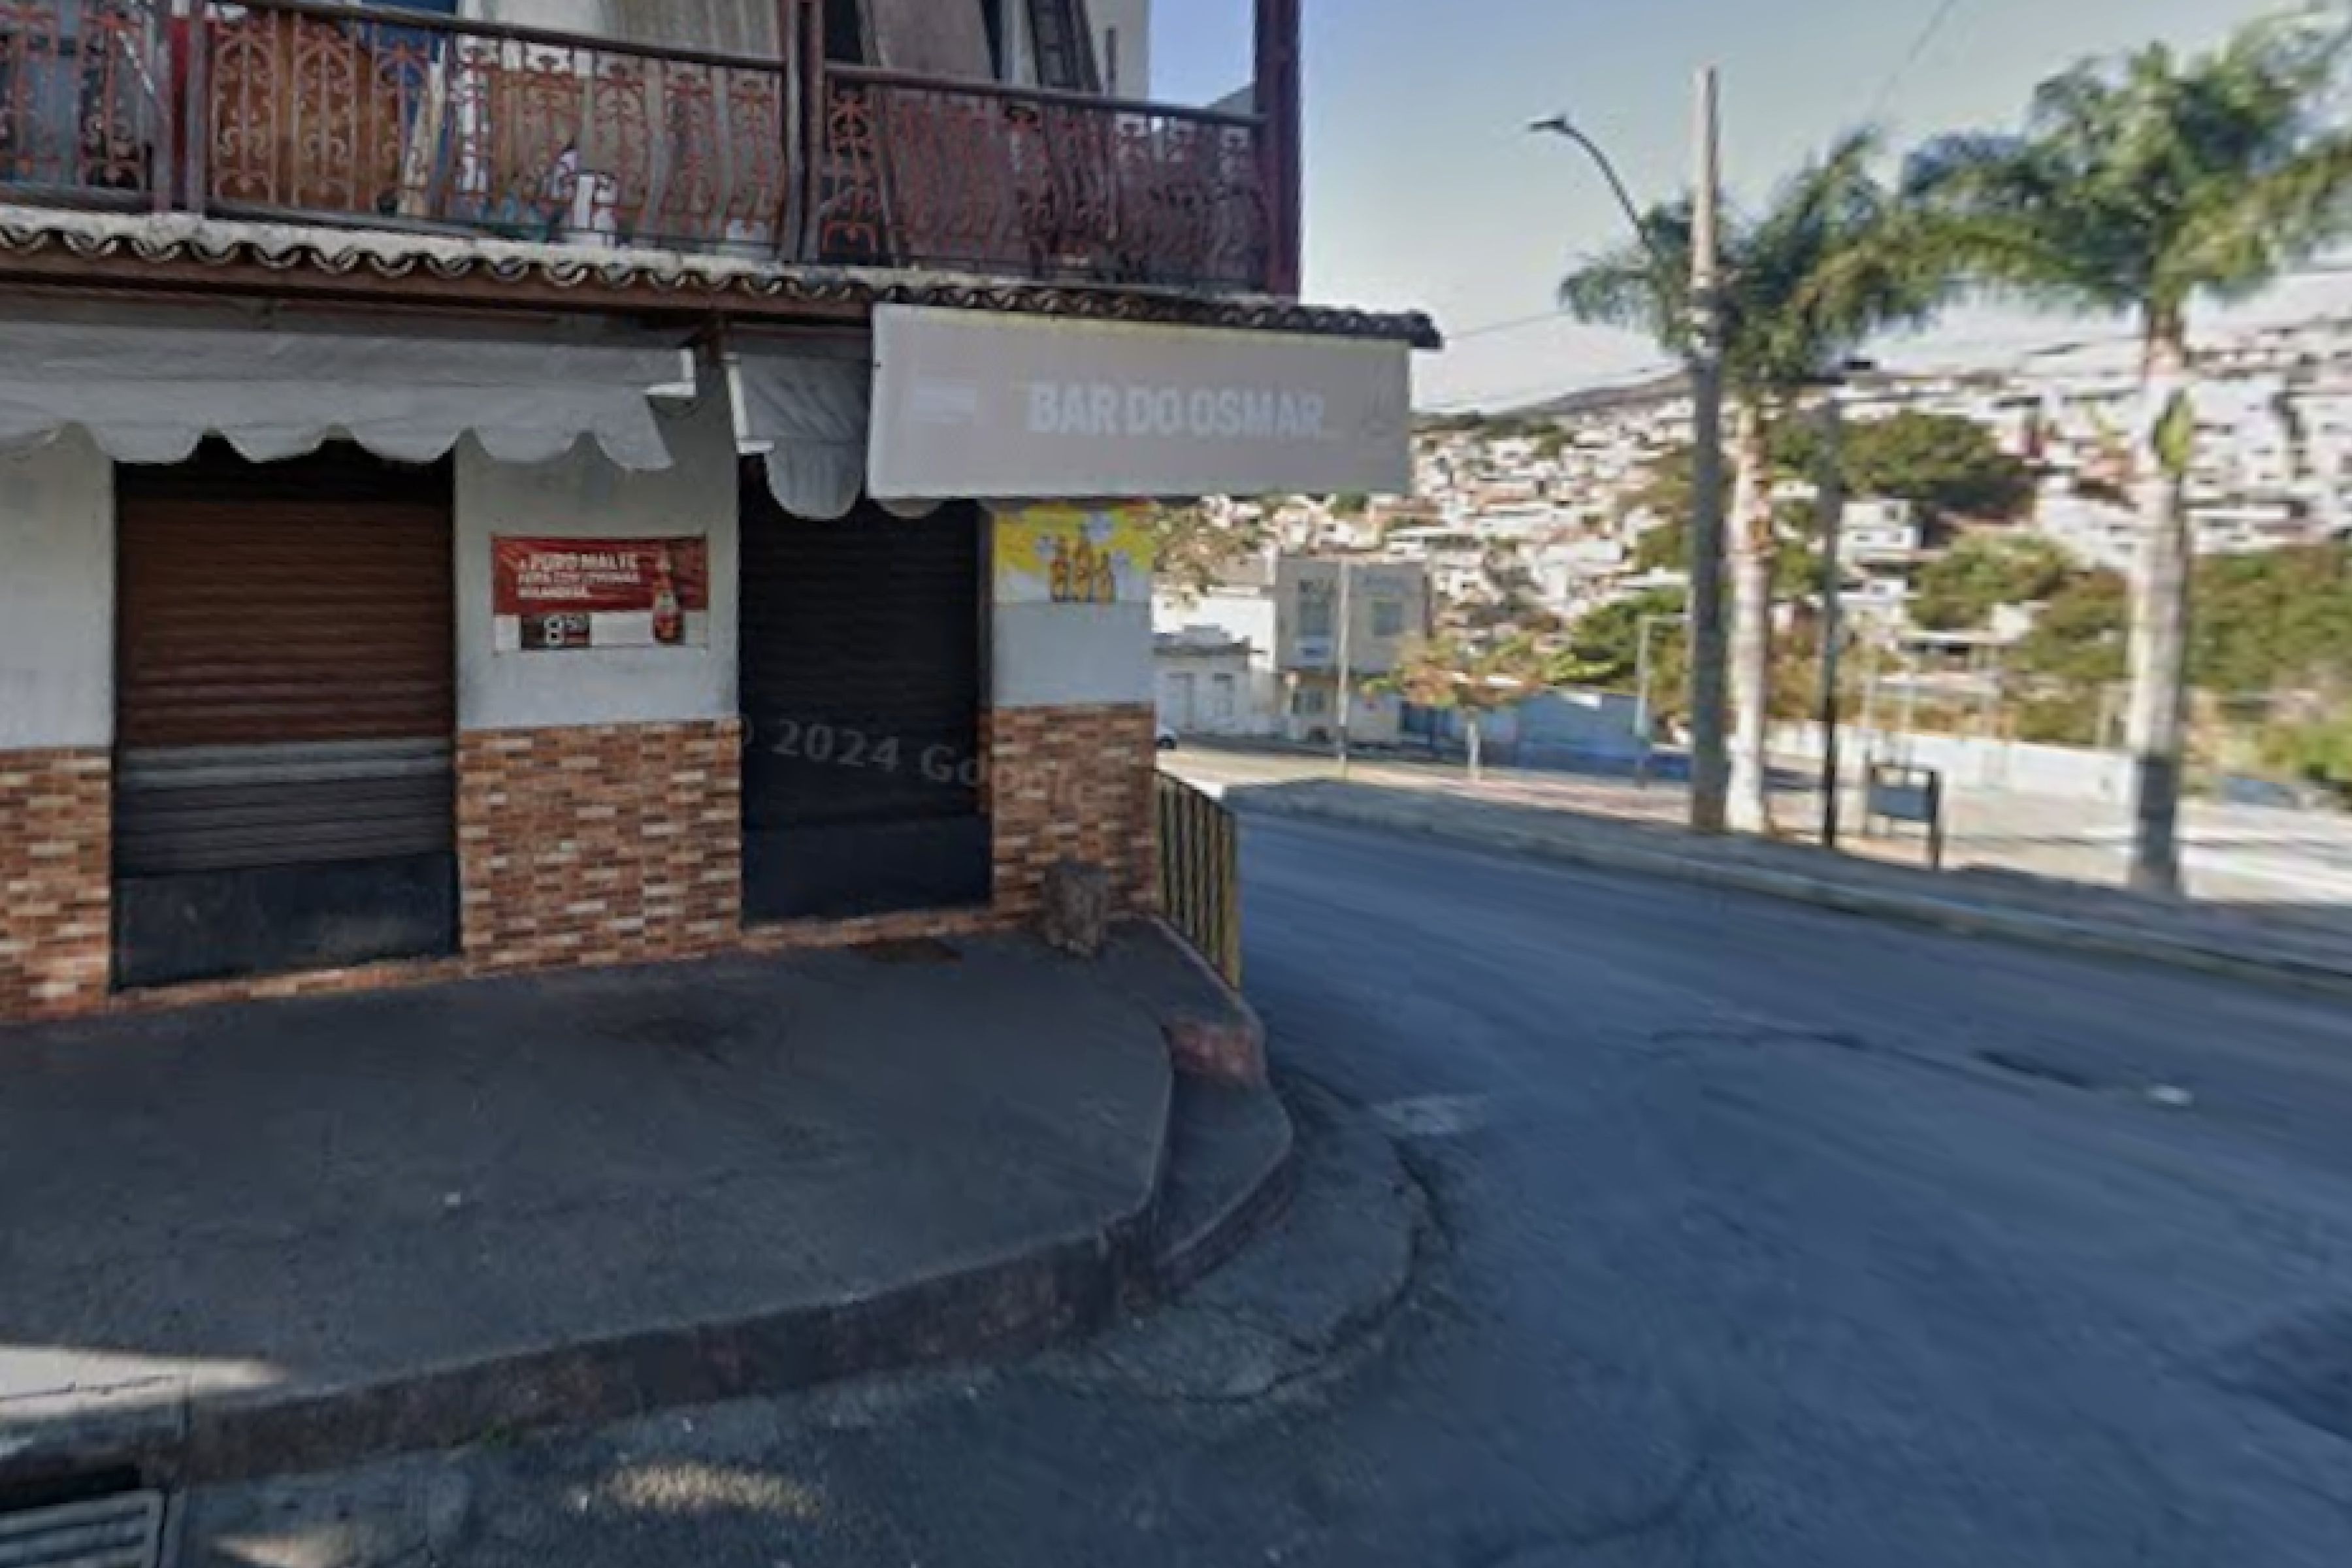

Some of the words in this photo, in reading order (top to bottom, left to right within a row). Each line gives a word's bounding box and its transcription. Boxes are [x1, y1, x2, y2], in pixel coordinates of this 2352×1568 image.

[1026, 382, 1119, 436] BAR
[1126, 385, 1178, 437] DO
[1190, 385, 1326, 441] OSMAR
